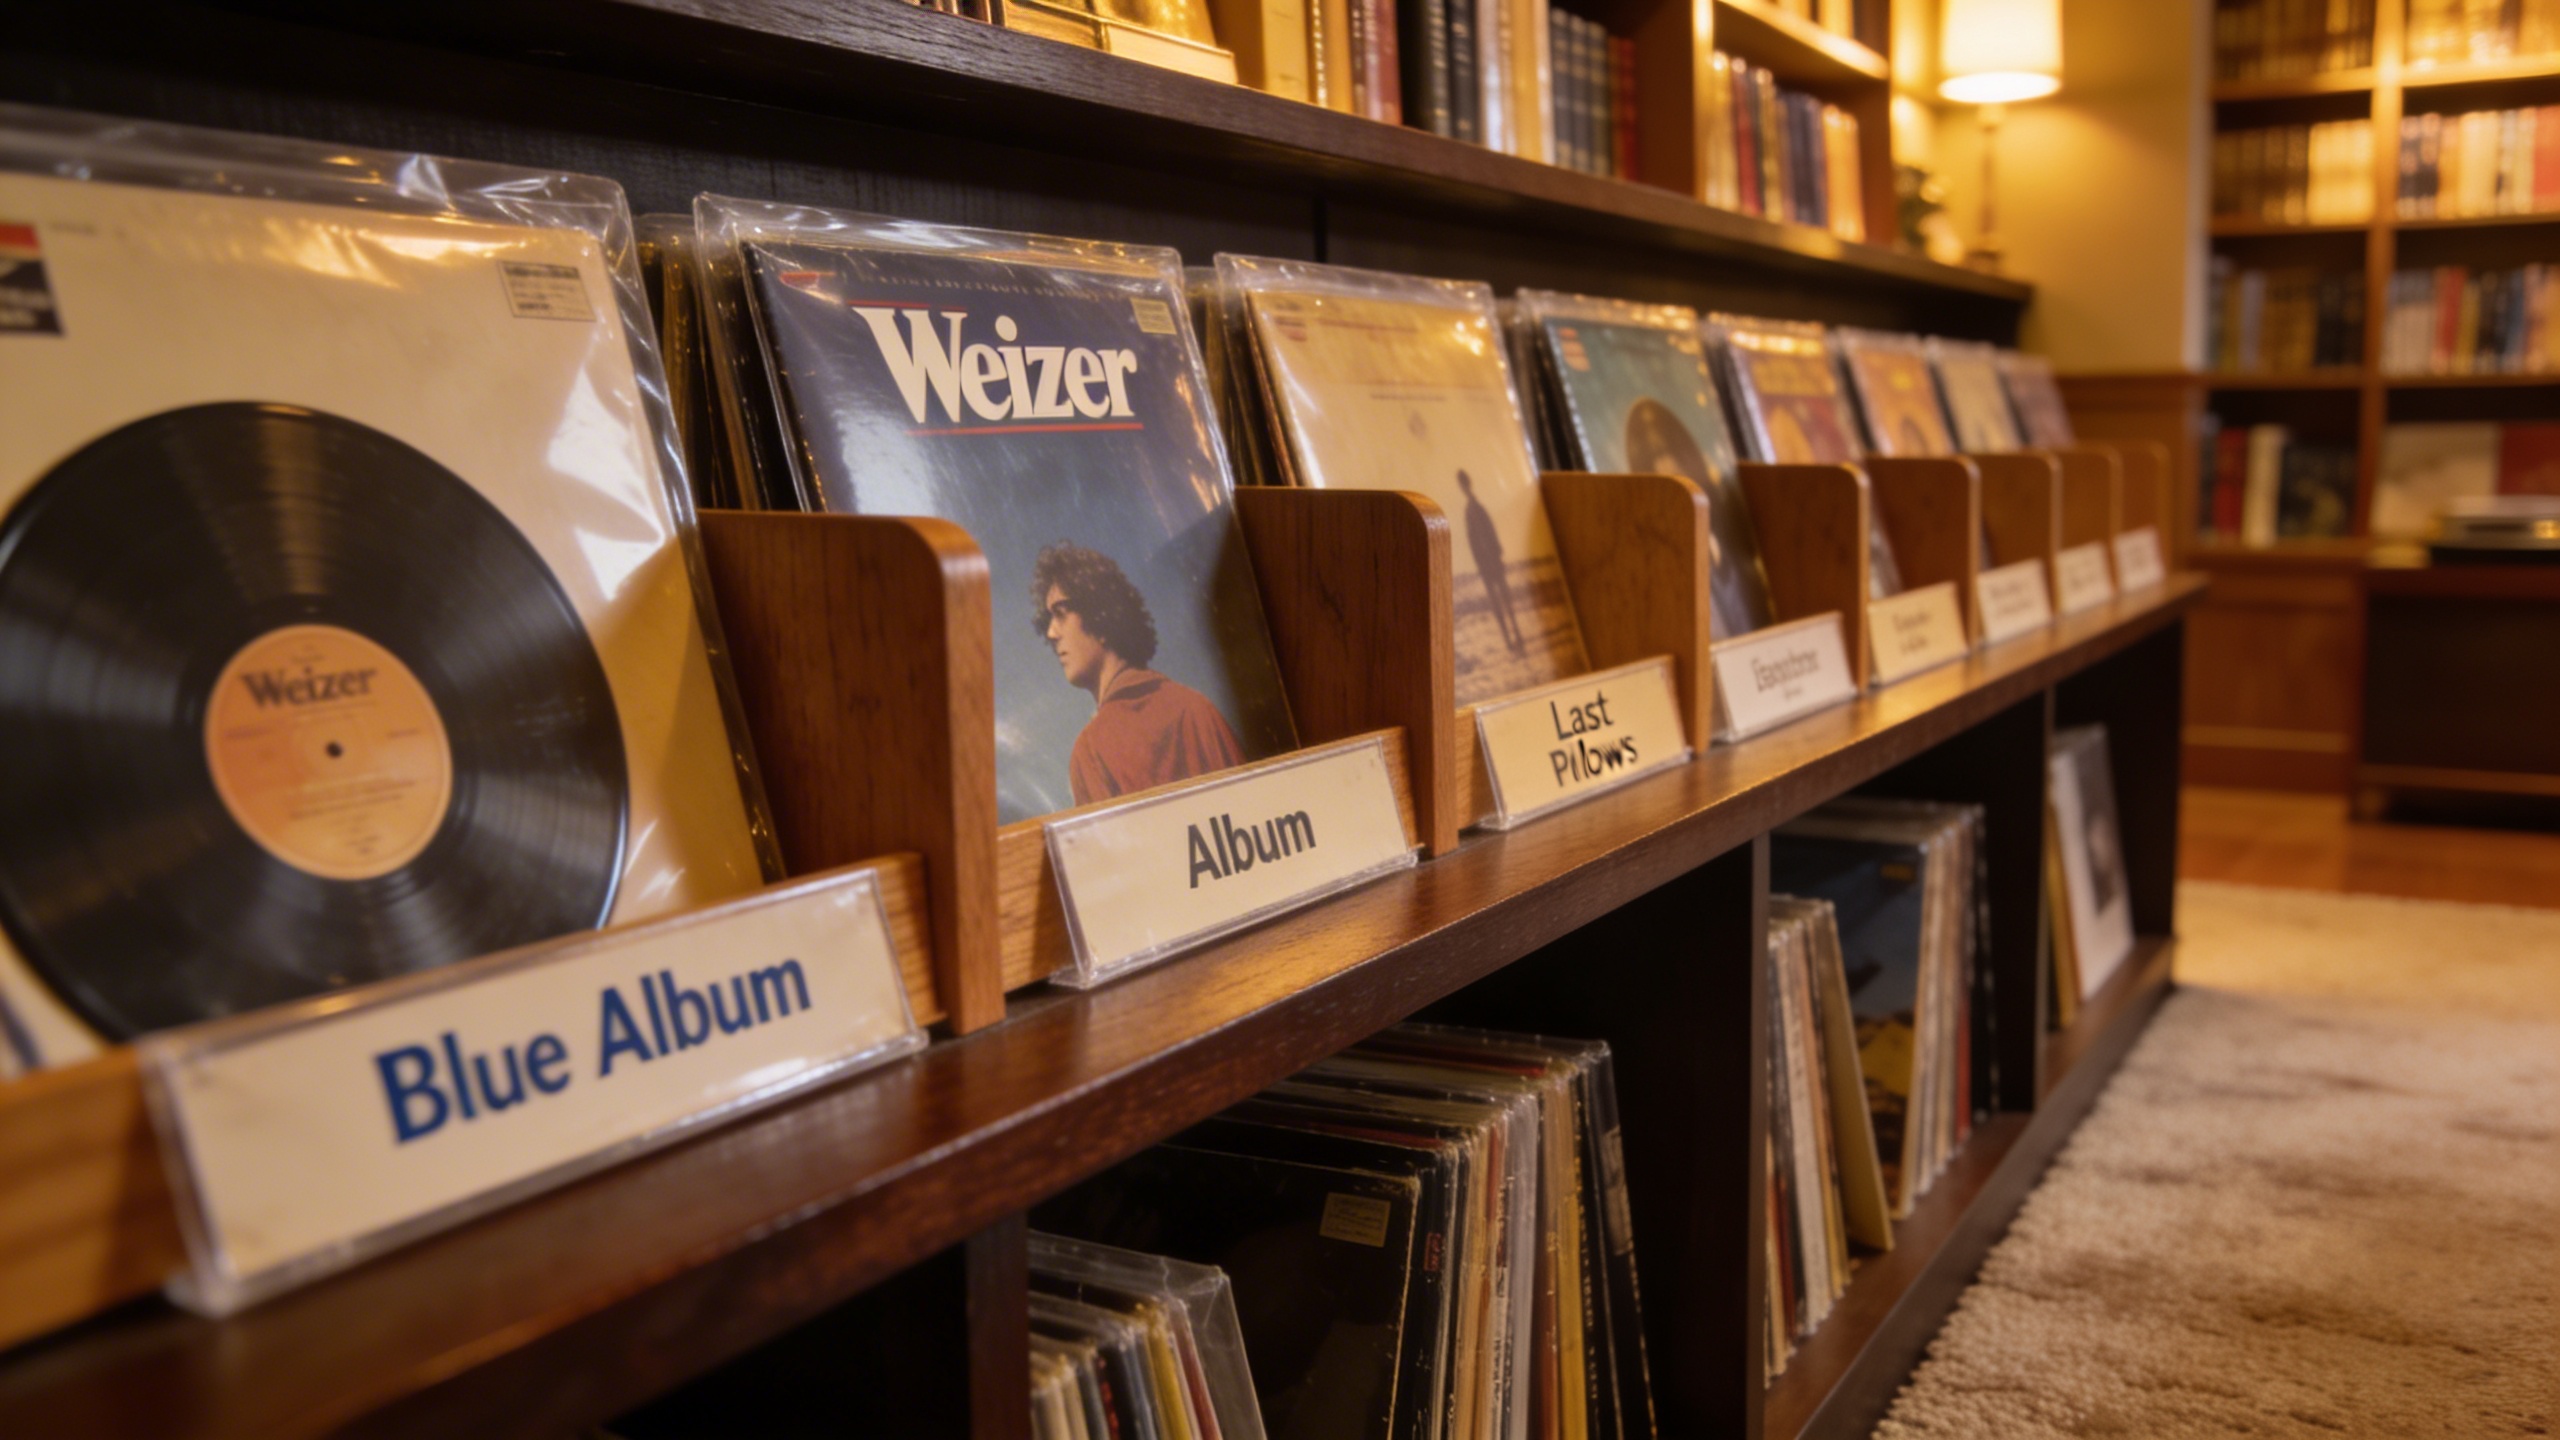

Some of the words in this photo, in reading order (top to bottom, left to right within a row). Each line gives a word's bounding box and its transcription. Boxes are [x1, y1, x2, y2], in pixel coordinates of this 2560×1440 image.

[852, 306, 1137, 423] Weizer
[240, 665, 377, 708] Weizer
[1550, 690, 1614, 740] Last
[1187, 810, 1316, 889] Album
[374, 1031, 571, 1145] Blue
[598, 958, 811, 1078] Album
